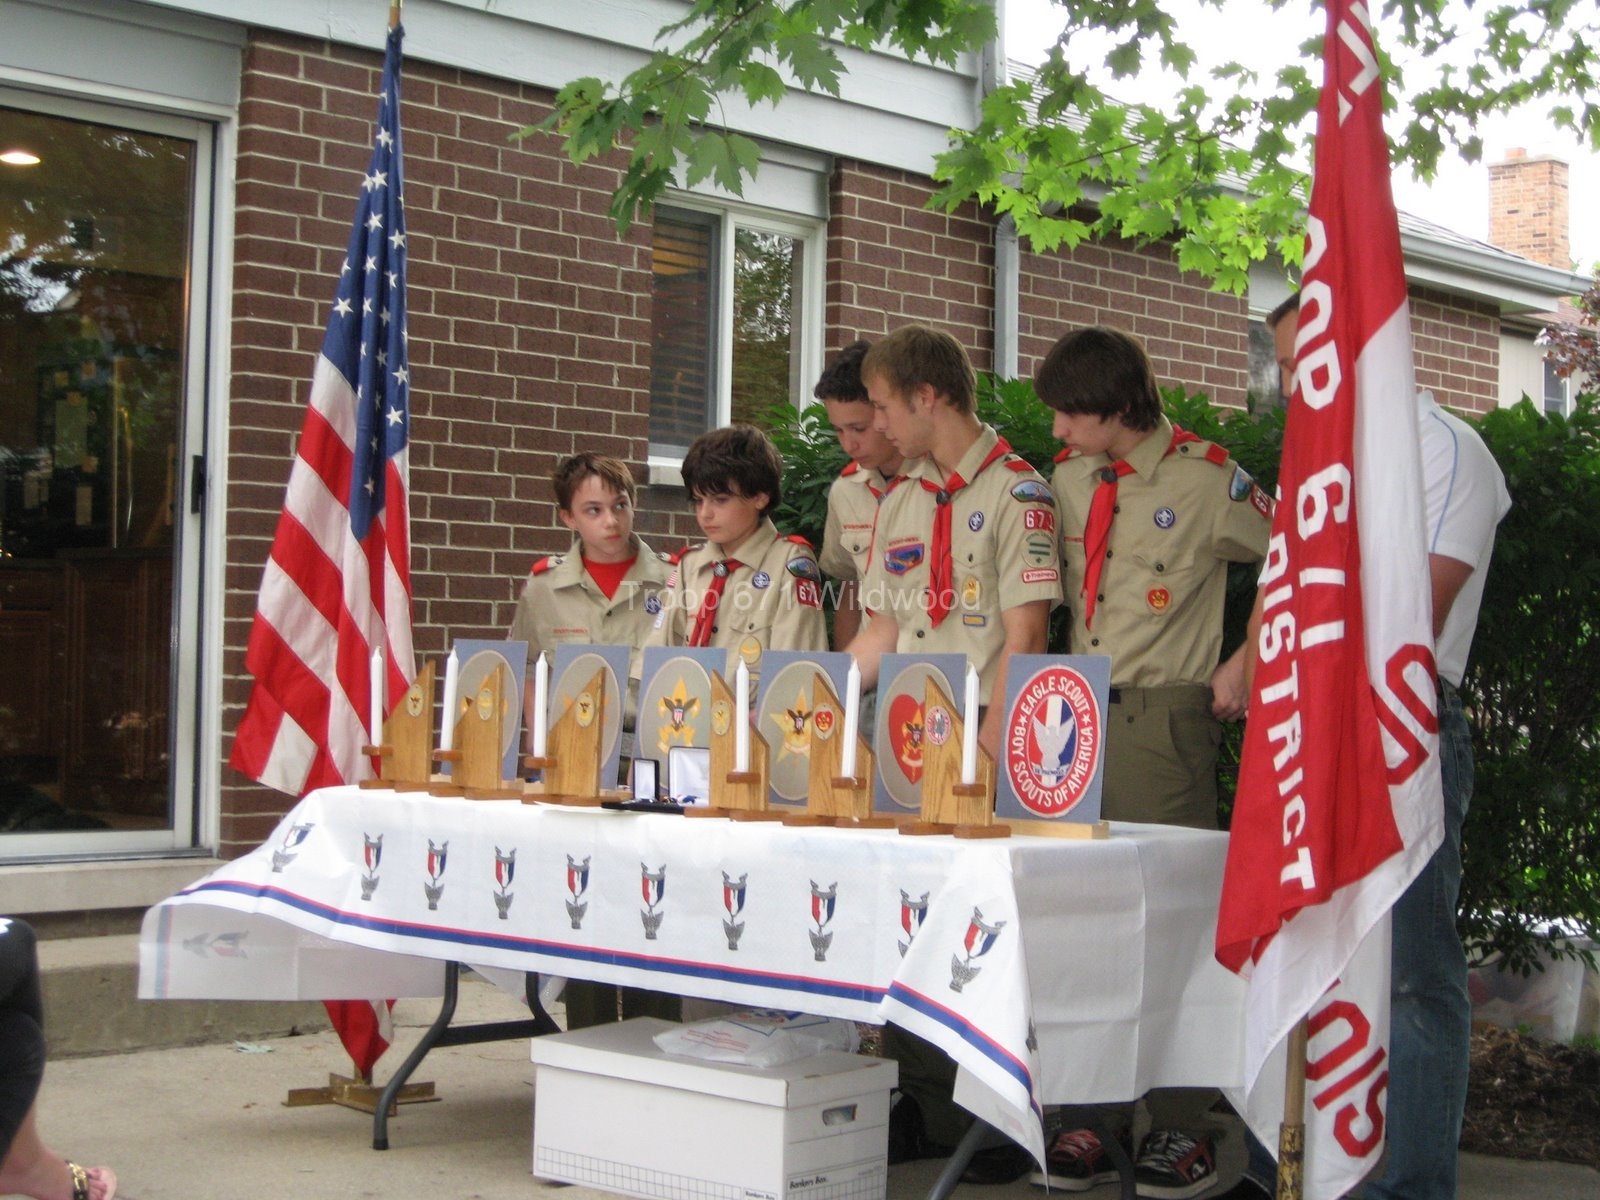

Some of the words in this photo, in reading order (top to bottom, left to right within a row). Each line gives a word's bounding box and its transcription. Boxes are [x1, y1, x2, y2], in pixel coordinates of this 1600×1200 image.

[1021, 675, 1056, 716] EAGLE
[1057, 675, 1091, 714] SCOUT
[1257, 531, 1317, 890] DISTRICT
[1012, 725, 1027, 758] BOY
[1069, 726, 1094, 795] AMERICA
[1013, 760, 1053, 808] SCOUTS
[1053, 785, 1070, 806] OF
